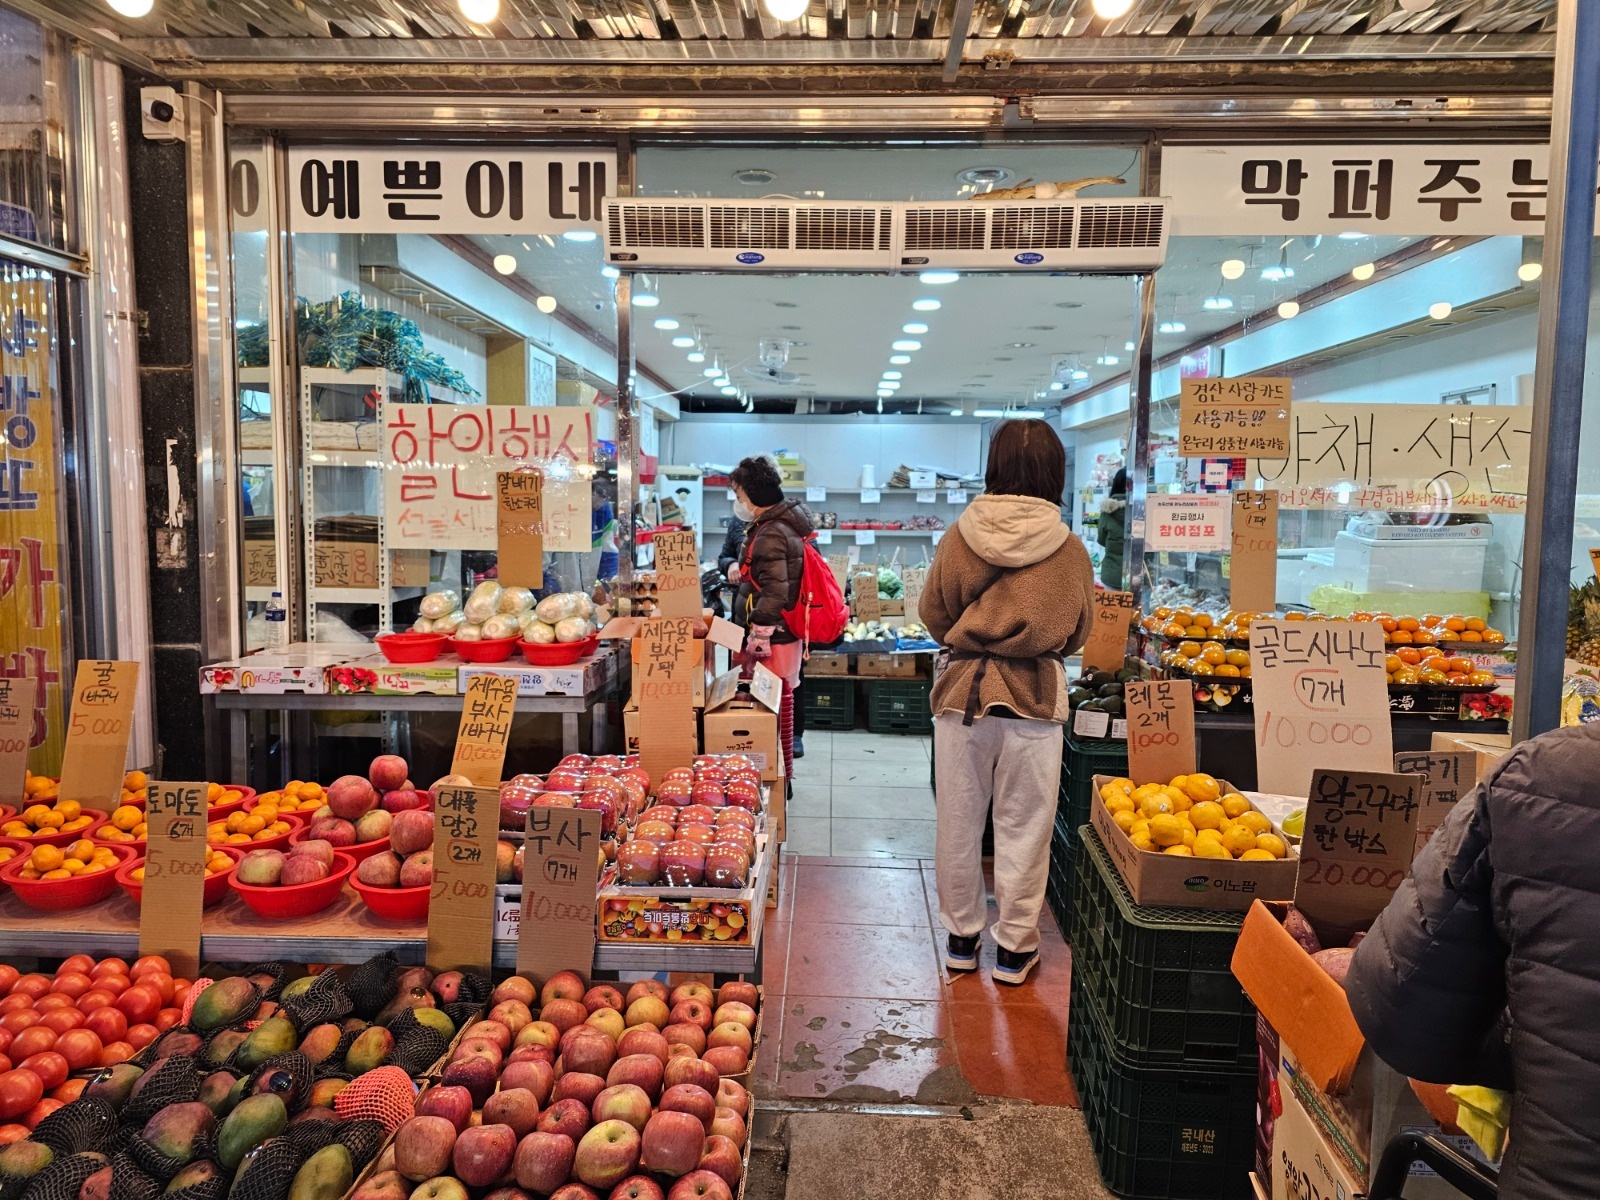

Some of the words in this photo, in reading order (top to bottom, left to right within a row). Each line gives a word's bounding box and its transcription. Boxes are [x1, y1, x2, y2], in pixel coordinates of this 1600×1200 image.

[1190, 382, 1225, 403] 경산
[1182, 435, 1213, 451] 온누리
[498, 472, 538, 494] 알배기
[1237, 493, 1271, 510] 단감
[1172, 513, 1205, 521] 환급행사
[1160, 525, 1215, 537] 참여점포
[1100, 610, 1119, 623] 4개
[644, 620, 690, 644] 제수용
[650, 643, 685, 661] 부사
[1254, 625, 1383, 669] 골드시나노
[94, 662, 115, 686] 귤
[469, 676, 516, 704] 제수용
[1128, 682, 1176, 709] 레몬
[1301, 677, 1345, 706] 7개
[469, 700, 510, 721] 부사
[1137, 710, 1170, 730] 2개
[460, 722, 509, 746] 1바구니
[1398, 755, 1459, 786] 딸기
[148, 786, 203, 816] 토마토
[170, 821, 194, 838] 6개
[441, 814, 477, 838] 망고
[528, 809, 592, 855] 부사
[453, 846, 481, 862] 2개
[548, 861, 578, 881] 7개
[1213, 879, 1258, 893] 이노팜
[1181, 1128, 1216, 1143] 국내산
